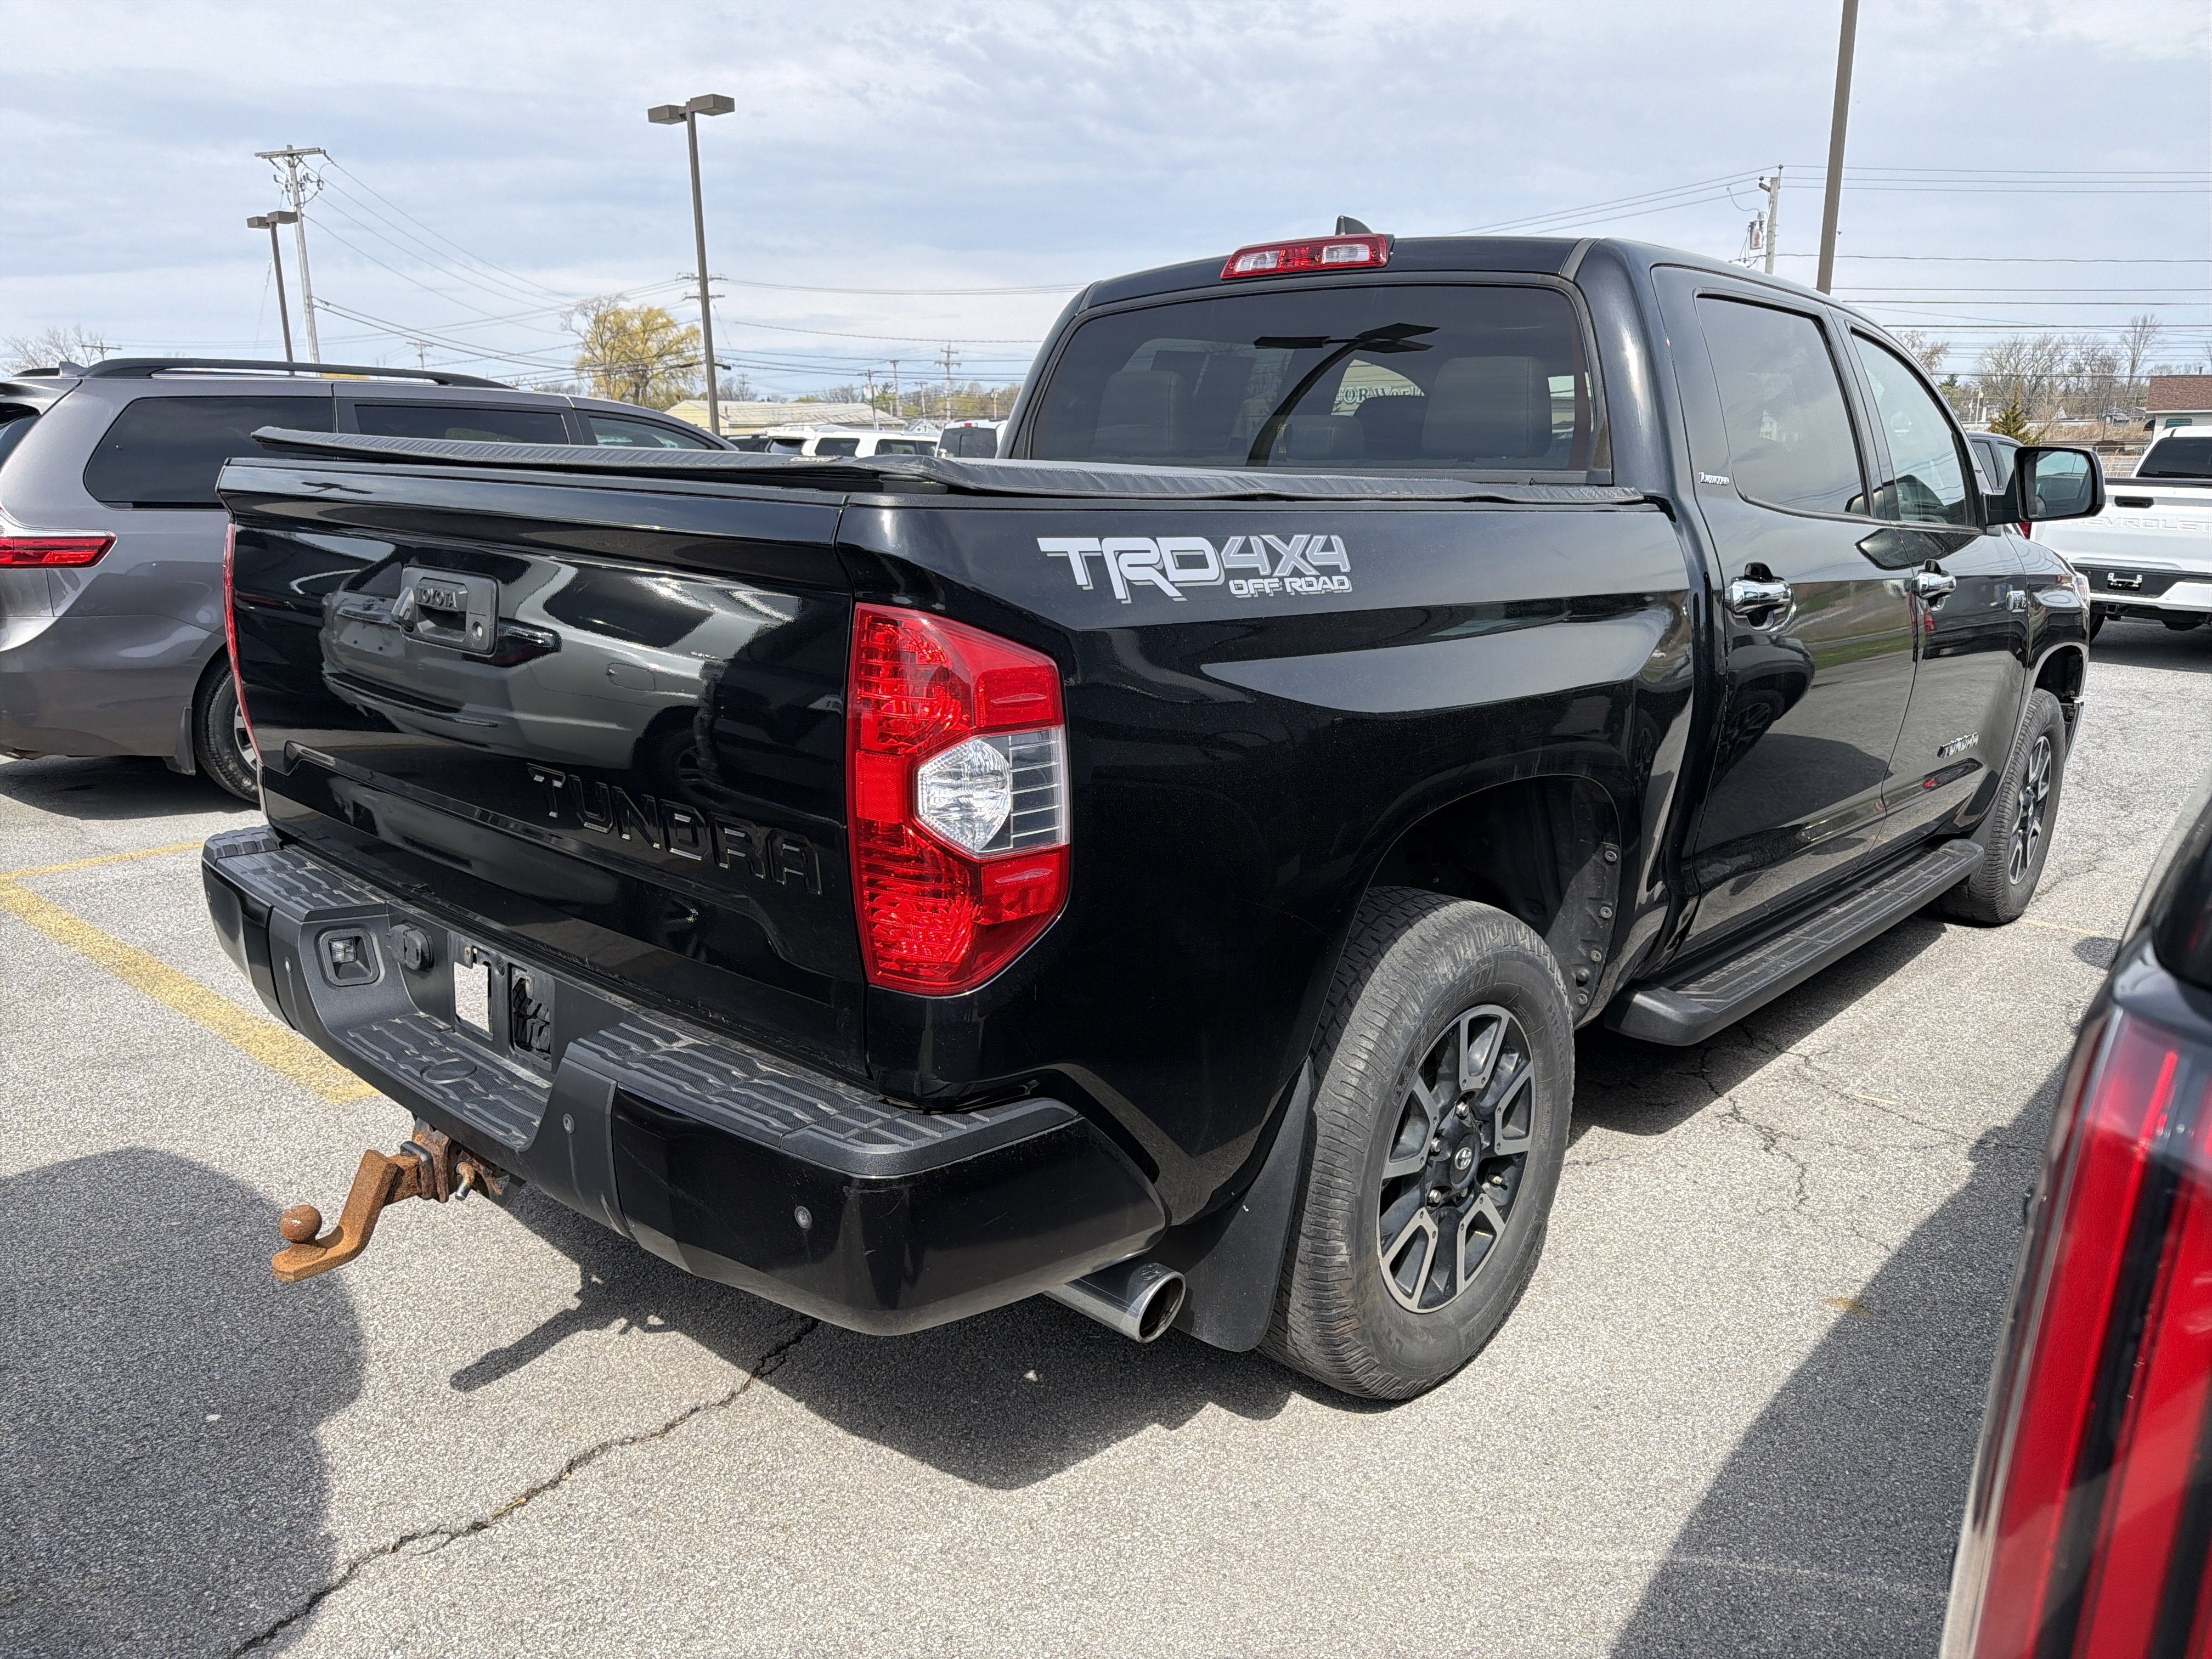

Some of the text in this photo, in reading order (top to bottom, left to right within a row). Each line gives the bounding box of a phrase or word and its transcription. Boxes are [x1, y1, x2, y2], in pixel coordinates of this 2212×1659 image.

[417, 585, 458, 609] TOYOTA
[1036, 537, 1224, 603] TRD
[1937, 731, 1979, 759] TUNDRA
[527, 763, 822, 895] TUNDRA
[1413, 961, 1496, 1064] MICHELIN
